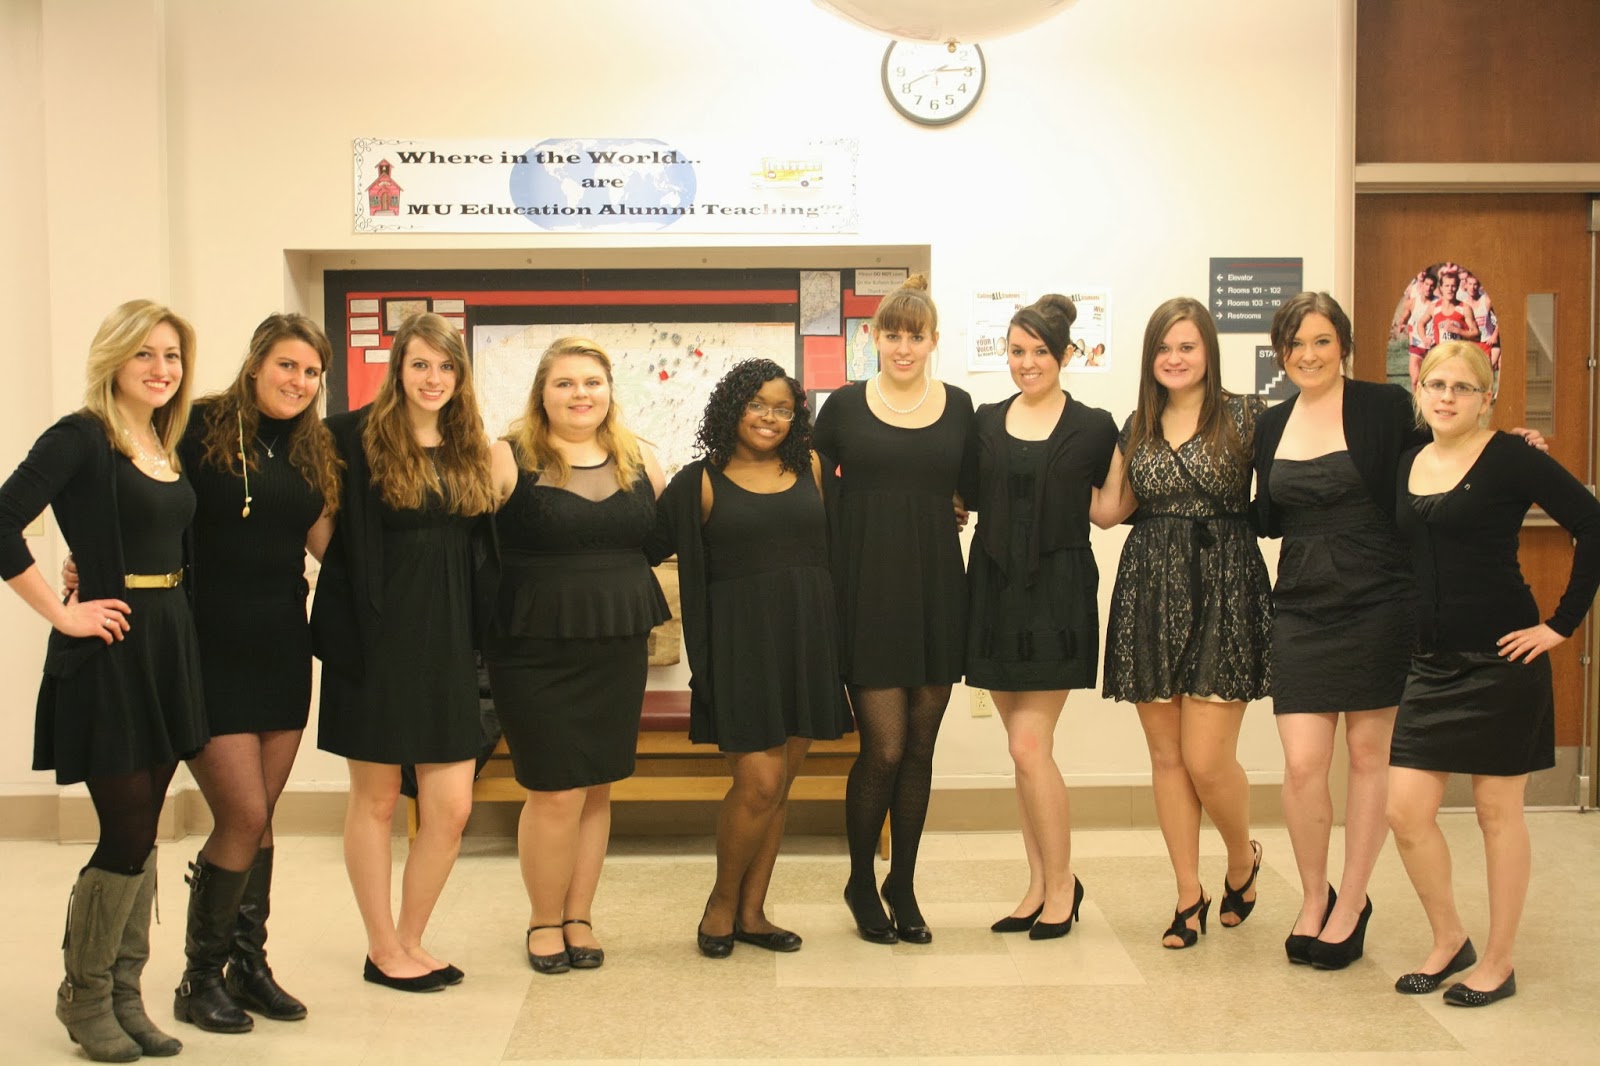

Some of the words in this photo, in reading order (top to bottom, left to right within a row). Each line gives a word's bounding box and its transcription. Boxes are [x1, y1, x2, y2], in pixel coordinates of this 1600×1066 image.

[896, 66, 906, 77] 9
[963, 66, 973, 77] 3
[902, 83, 912, 94] 8
[957, 83, 967, 93] 4
[914, 95, 923, 105] 7
[929, 99, 939, 110] 6
[945, 94, 954, 105] 5
[397, 150, 493, 164] Where
[500, 151, 530, 164] in
[534, 150, 581, 164] the
[589, 150, 702, 164] World...
[581, 177, 624, 188] are
[407, 203, 451, 216] MU
[459, 203, 592, 216] Education
[598, 203, 696, 216] Alumni
[1227, 273, 1254, 281] Elevator
[1258, 349, 1277, 358] STA
